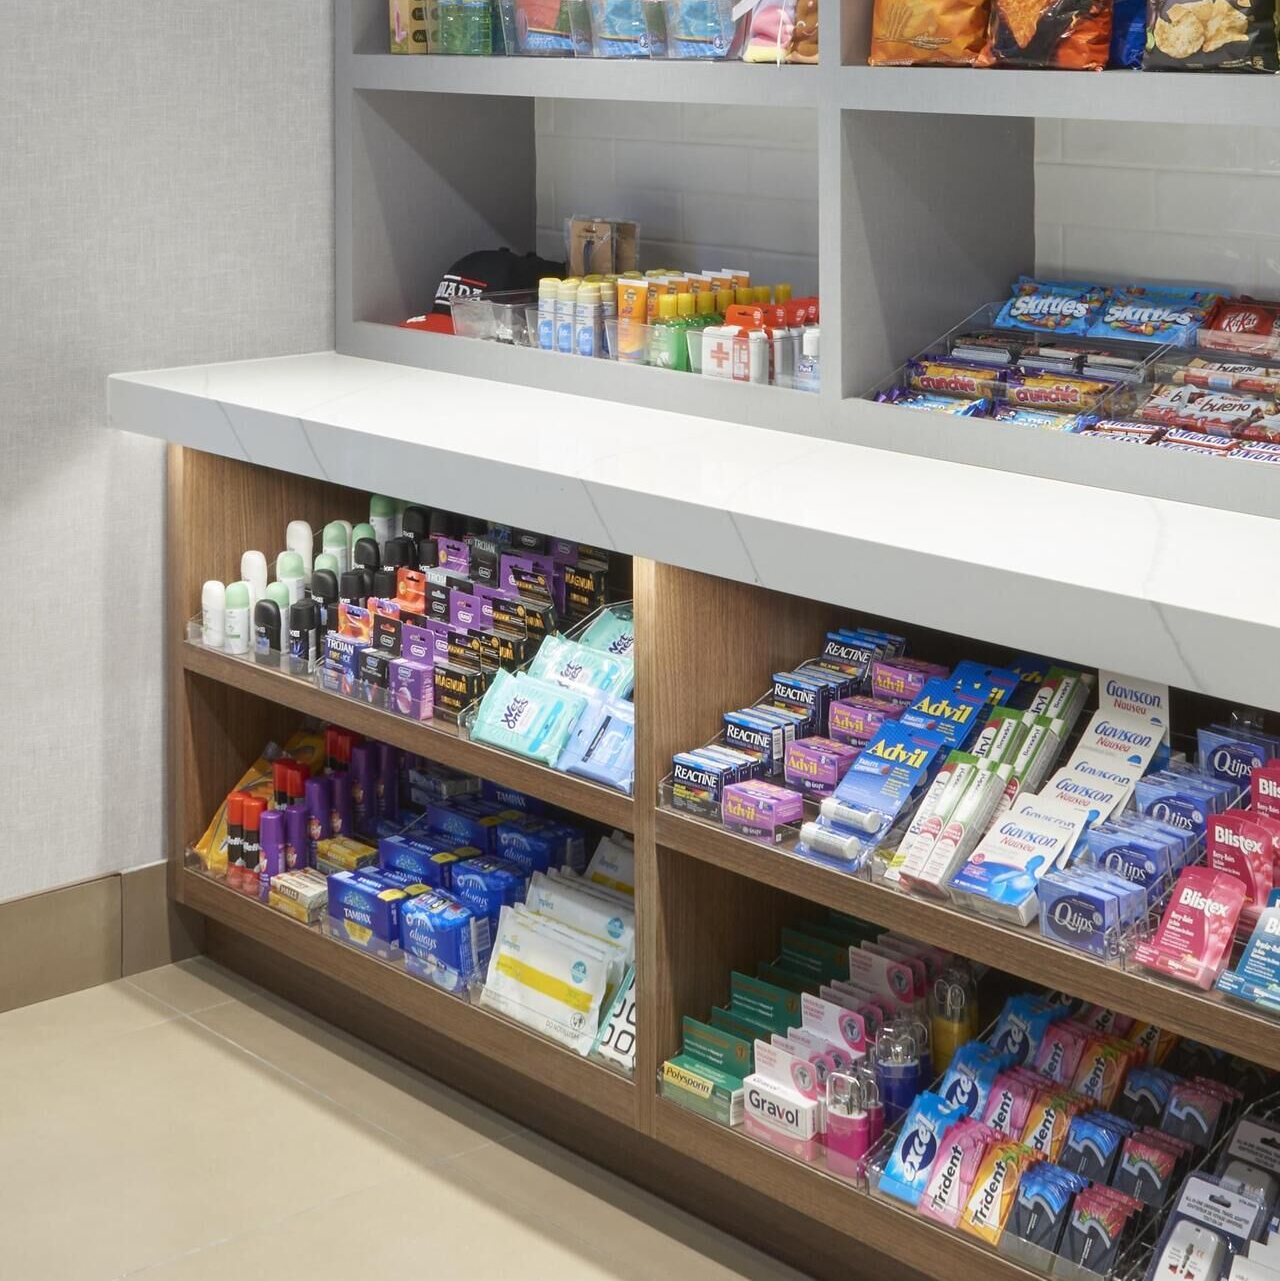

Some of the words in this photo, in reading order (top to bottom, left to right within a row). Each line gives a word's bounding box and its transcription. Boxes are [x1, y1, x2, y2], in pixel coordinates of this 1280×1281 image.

[435, 282, 482, 301] NADA
[1013, 296, 1089, 318] Skittles
[1105, 306, 1193, 325] Skittles
[1200, 399, 1251, 413] bueno
[565, 572, 594, 591] MAGNUM
[327, 638, 354, 655] TROJAN
[825, 642, 870, 663] REACTINE
[436, 673, 467, 694] MAGNUM
[775, 682, 815, 705] REACTINE
[1106, 680, 1161, 707] Gaviscon
[502, 695, 521, 723] Wet
[912, 696, 973, 724] Advil
[1114, 699, 1147, 715] Nausea
[727, 725, 770, 748] REACTINE
[1095, 721, 1152, 747] Gaviscon
[1096, 736, 1131, 753] Nausea
[867, 740, 928, 768] Advil
[674, 765, 717, 788] REACTINE
[1056, 778, 1114, 803] Gaviscon
[1056, 791, 1090, 807] Nausea
[1000, 822, 1057, 848] Gaviscon
[1000, 836, 1036, 852] Nausea
[1215, 826, 1264, 855] Blistex
[461, 888, 489, 908] always
[1180, 888, 1229, 918] Blistex
[344, 907, 371, 925] TAMPAX
[410, 928, 437, 950] always
[666, 1068, 710, 1093] Polysporin
[749, 1089, 799, 1127] Gravol
[903, 1114, 936, 1181] excel
[931, 1144, 963, 1212] Trident
[971, 1159, 1007, 1227] Trident
